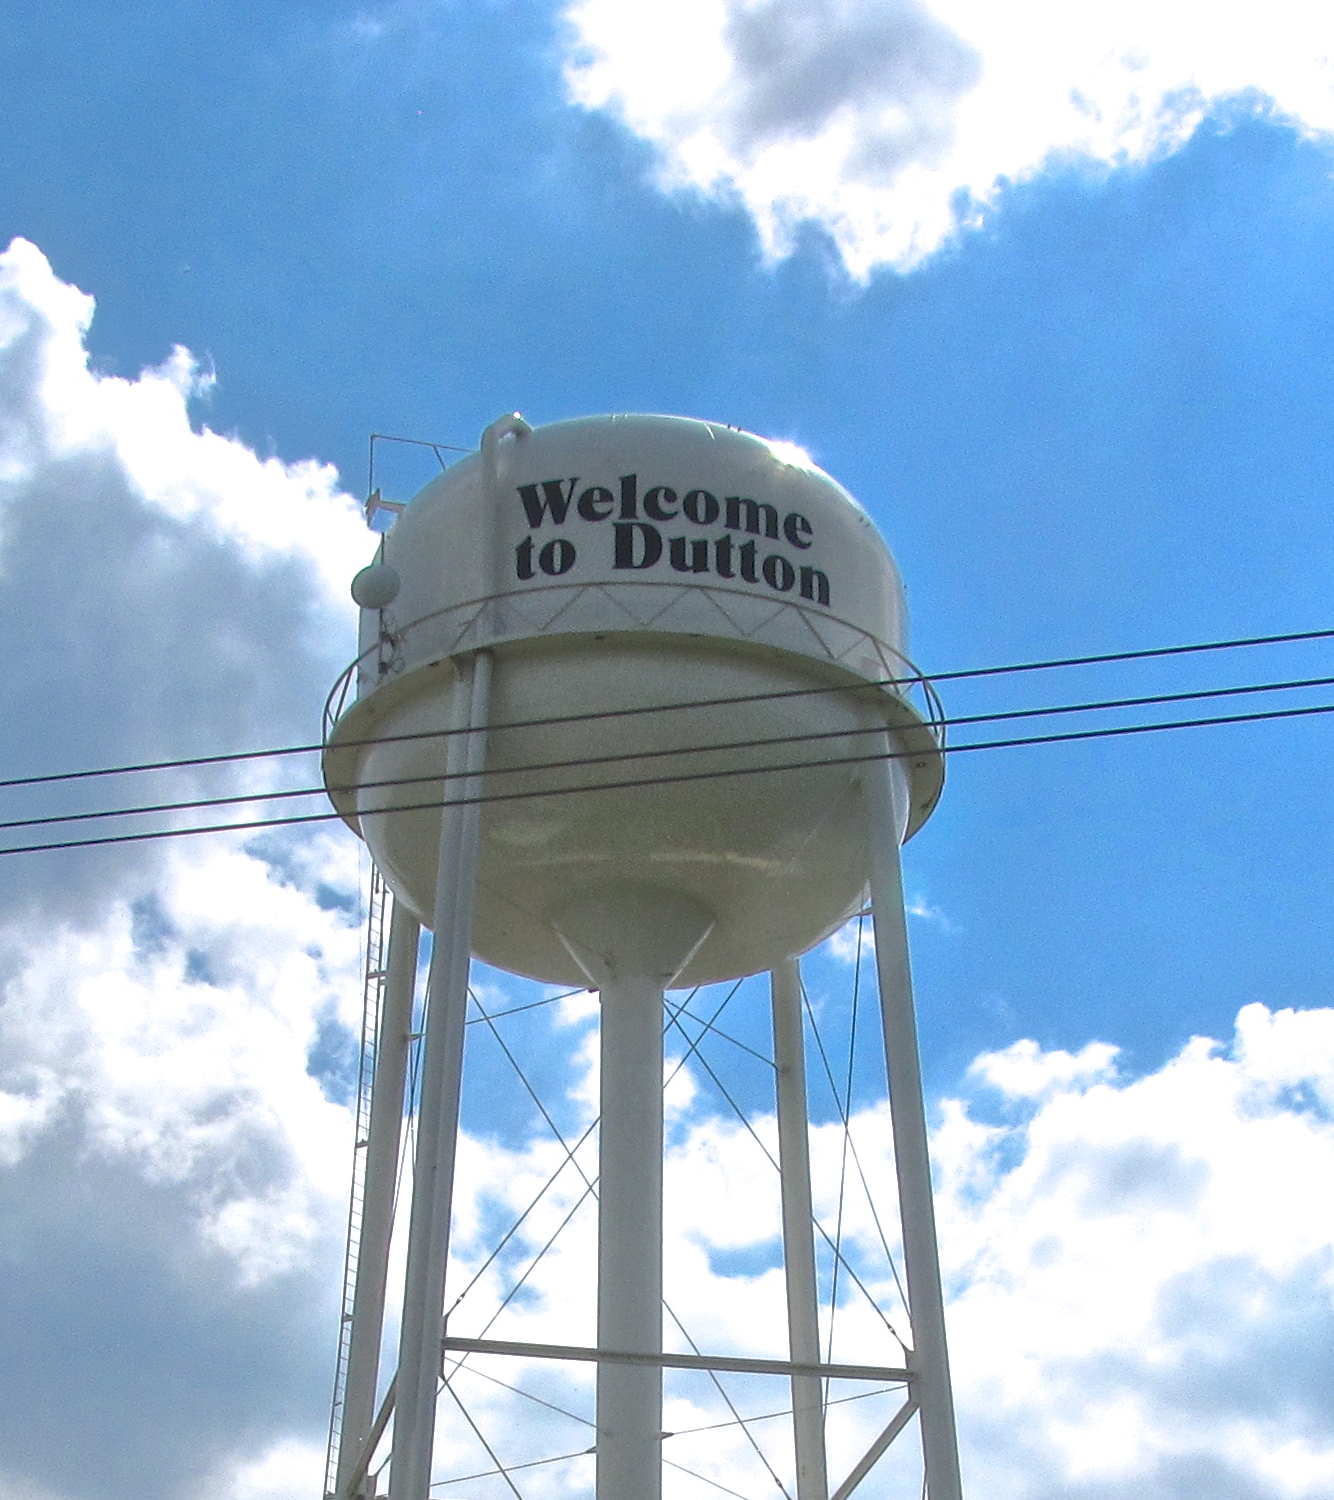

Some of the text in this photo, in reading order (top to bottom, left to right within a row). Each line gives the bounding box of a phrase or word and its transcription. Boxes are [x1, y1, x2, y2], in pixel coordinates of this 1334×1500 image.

[517, 474, 813, 549] Welcome
[516, 522, 830, 606] to Dutton
